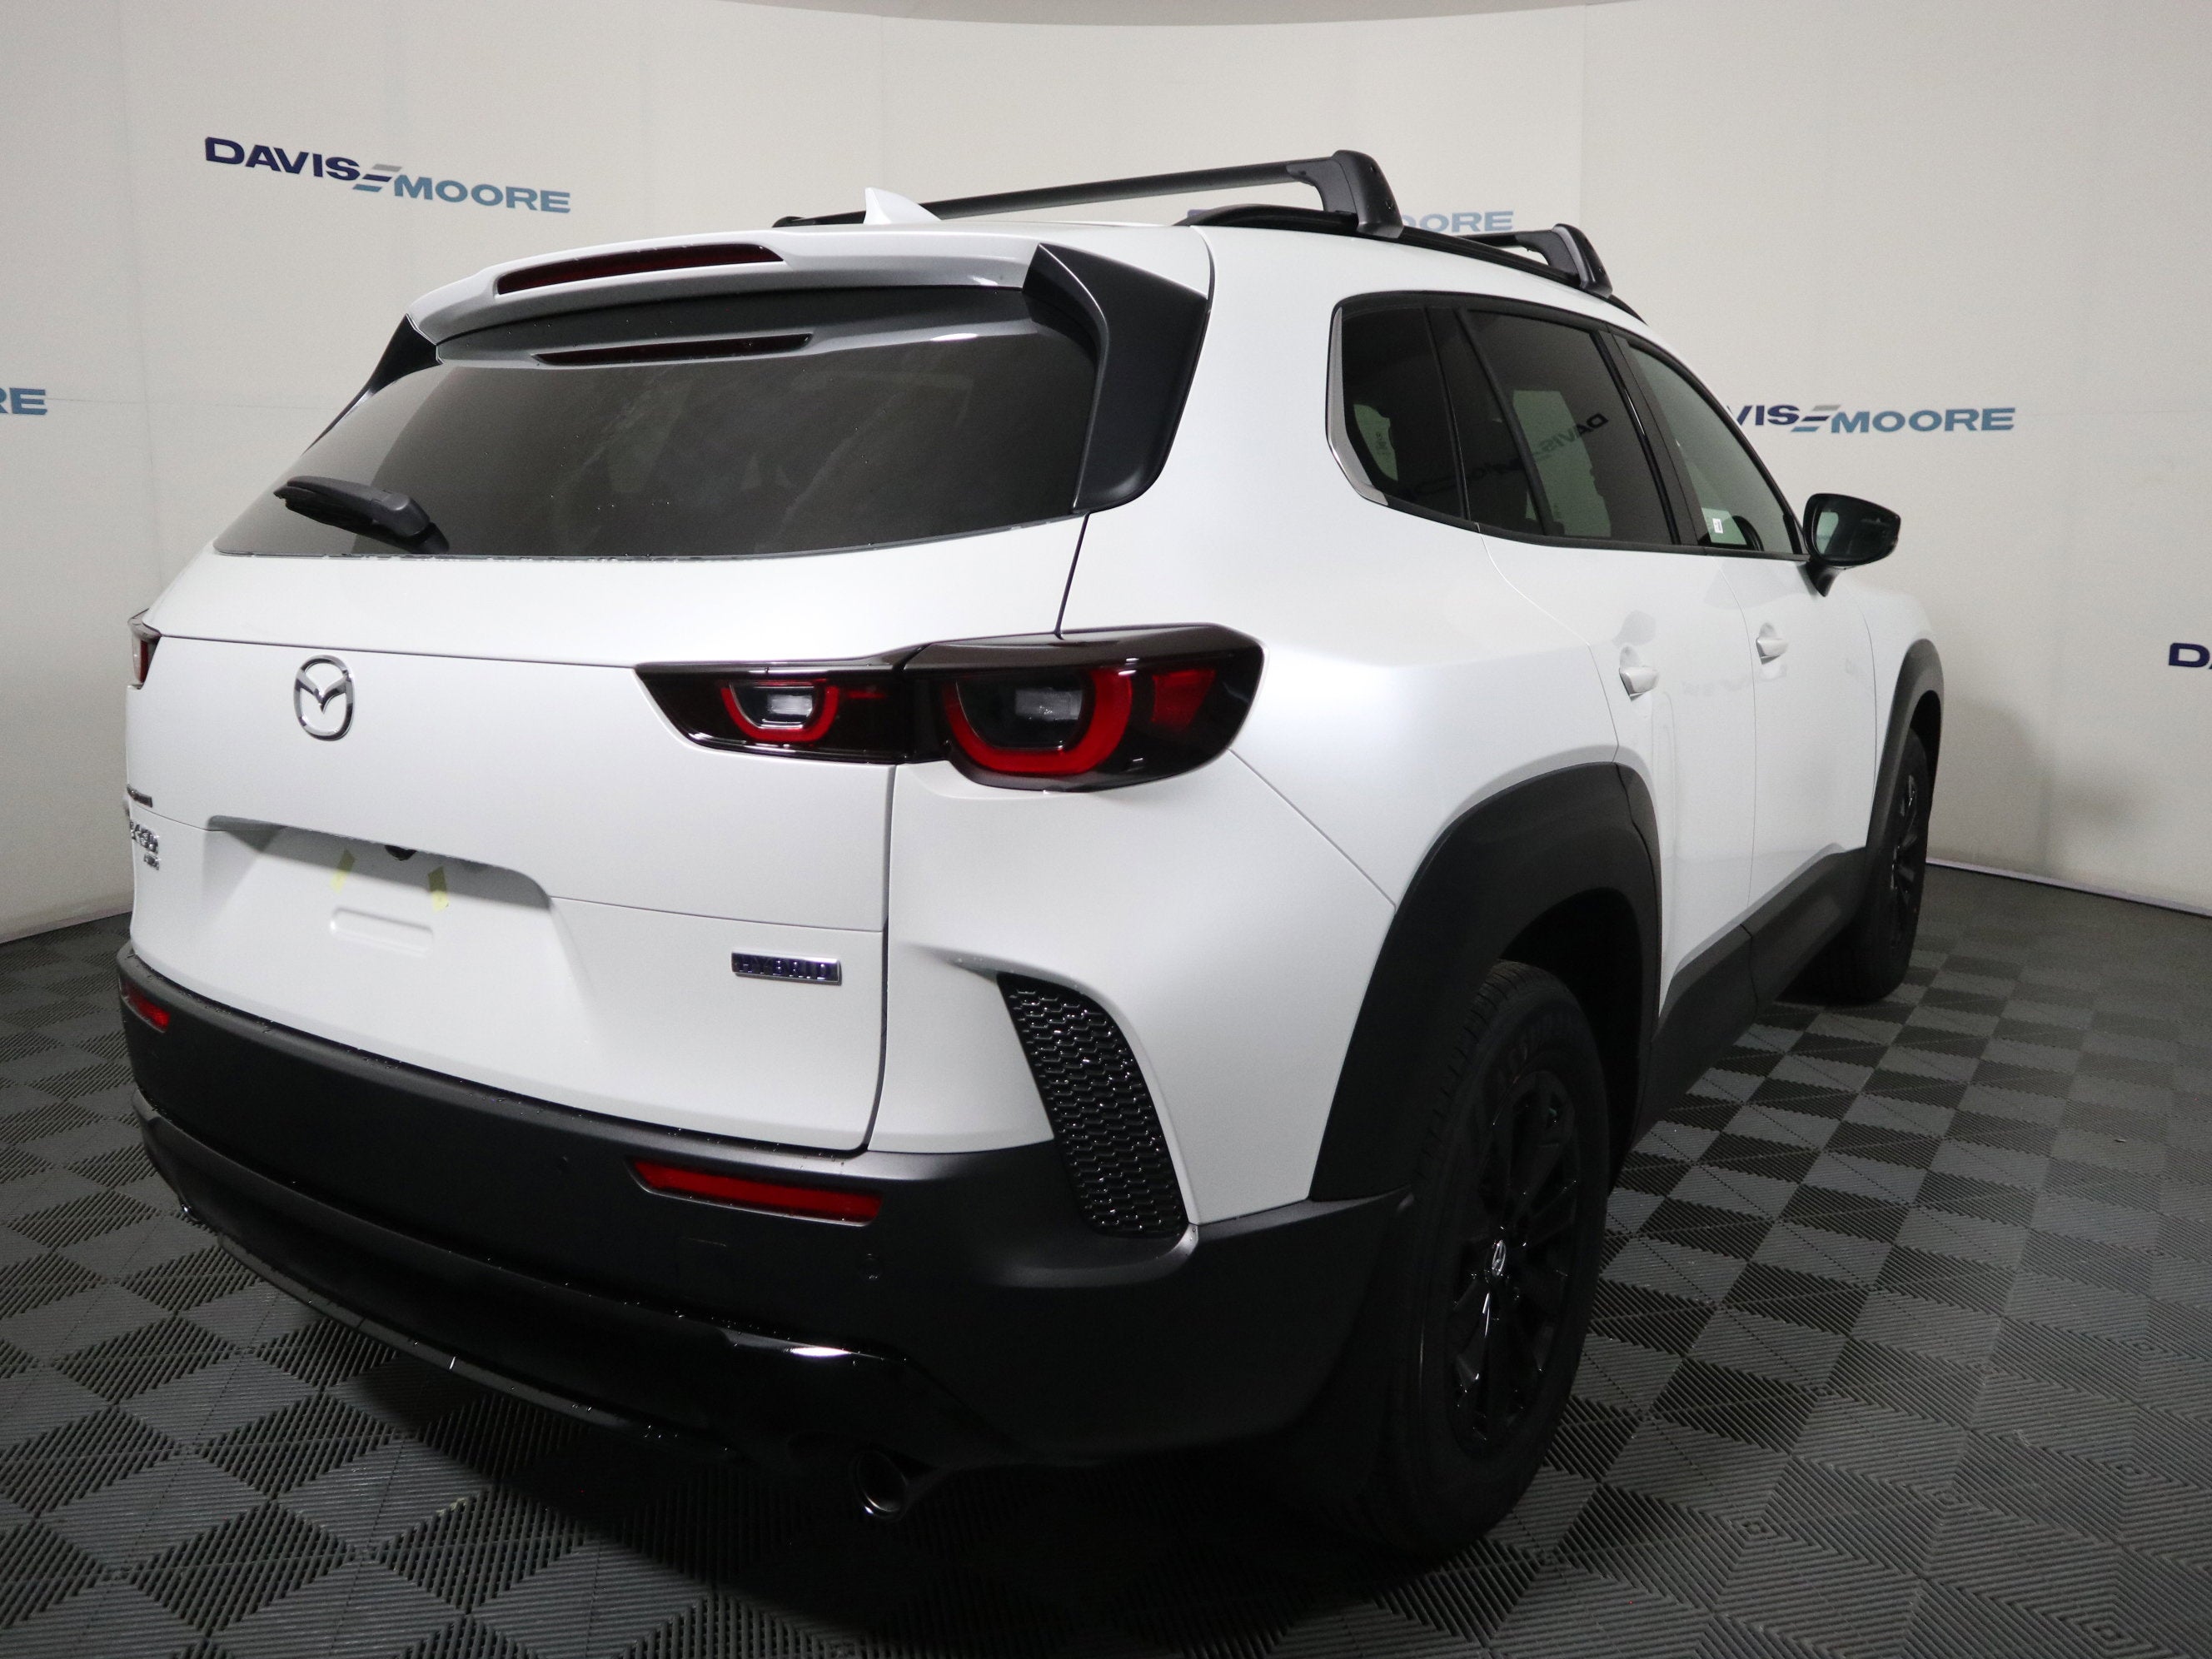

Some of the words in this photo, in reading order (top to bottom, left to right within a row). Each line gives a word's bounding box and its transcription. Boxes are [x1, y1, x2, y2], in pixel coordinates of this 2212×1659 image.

[205, 137, 361, 182] DAVIS
[395, 175, 570, 213] MOORE
[1831, 407, 2015, 433] MOORE
